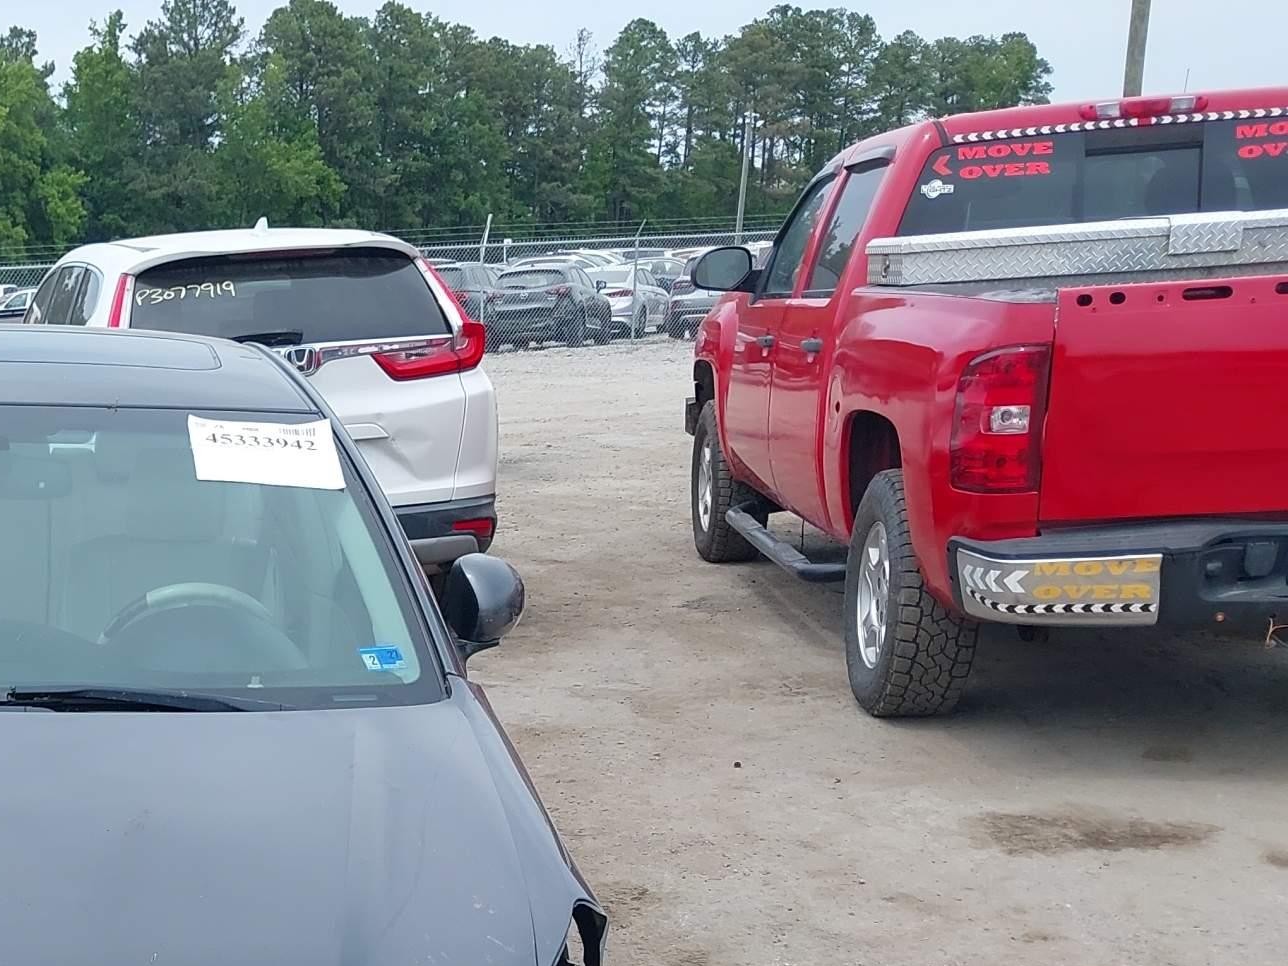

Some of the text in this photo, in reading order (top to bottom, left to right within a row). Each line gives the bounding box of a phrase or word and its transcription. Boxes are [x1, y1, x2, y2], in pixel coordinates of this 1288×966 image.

[958, 142, 1054, 161] MOVE
[959, 162, 1051, 180] OVER
[135, 280, 236, 306] P3077919
[205, 433, 318, 451] 45333942
[1033, 559, 1160, 577] MOVE
[1032, 583, 1152, 600] OVER
